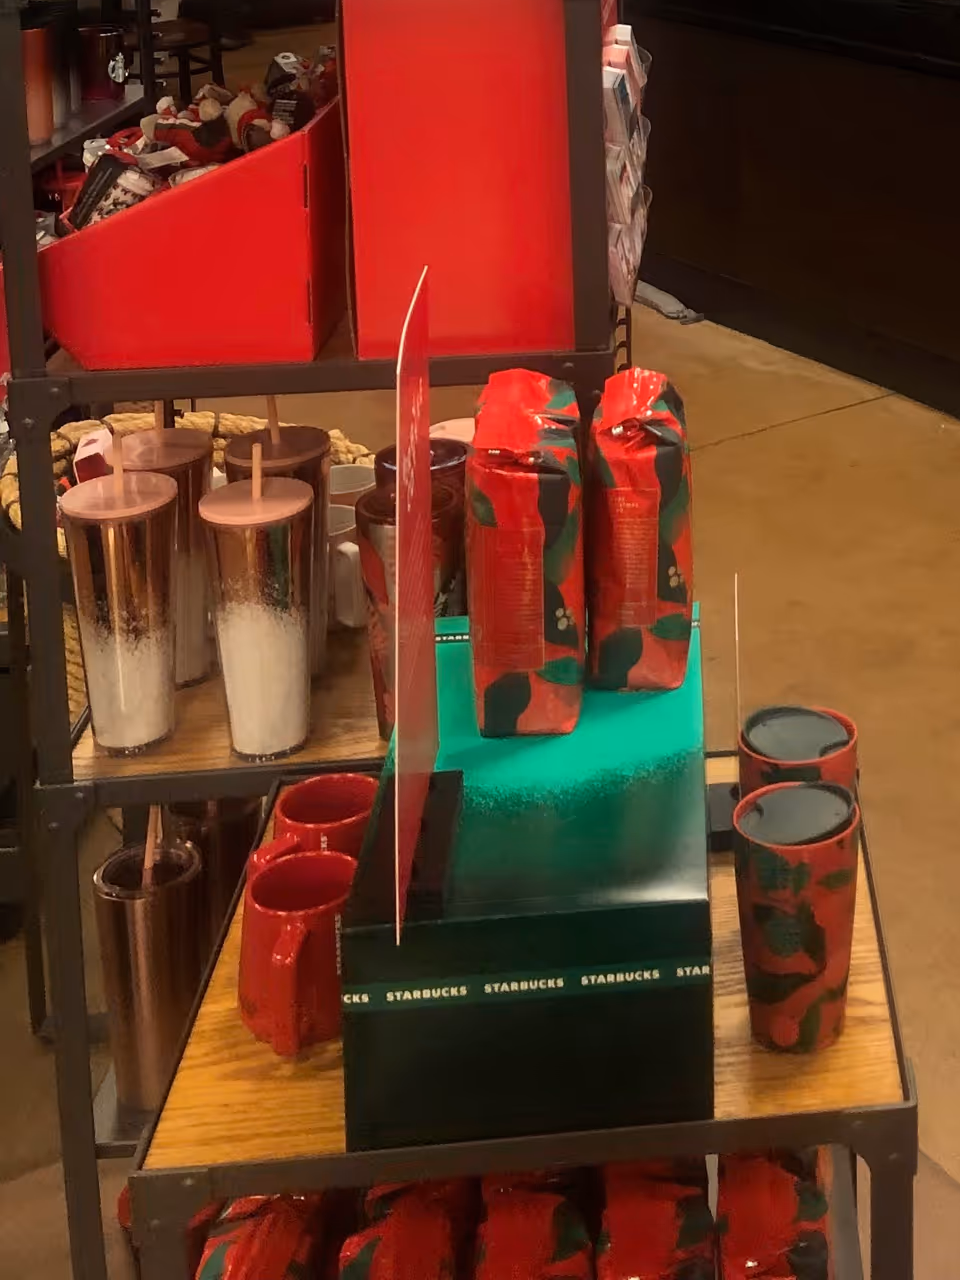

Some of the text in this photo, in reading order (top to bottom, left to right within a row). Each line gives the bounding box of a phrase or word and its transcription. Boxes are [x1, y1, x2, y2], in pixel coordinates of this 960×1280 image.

[341, 964, 711, 1004] CKS STARBUCKS STARBUCKS STARBUCKS STAR
